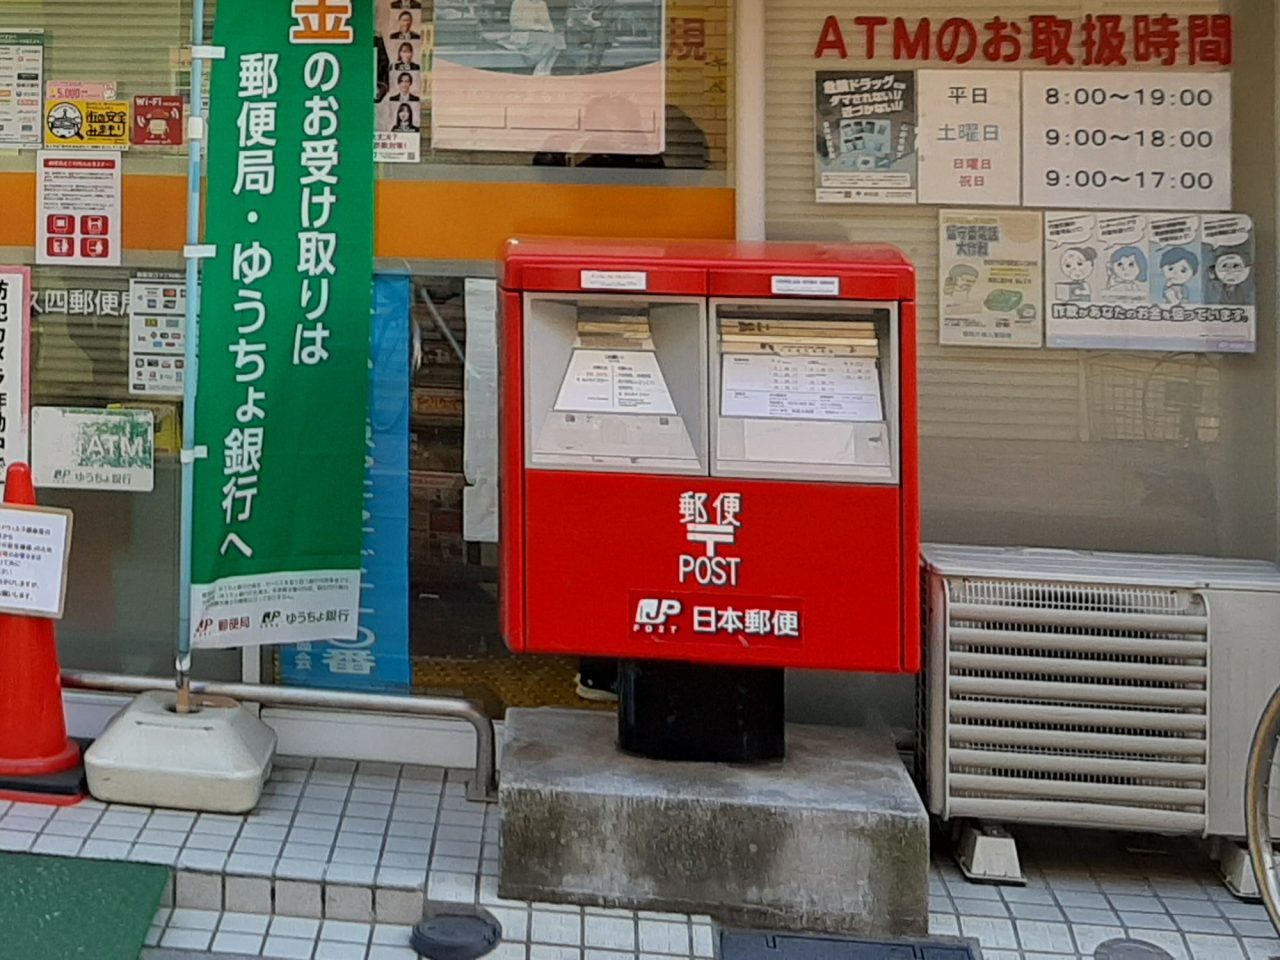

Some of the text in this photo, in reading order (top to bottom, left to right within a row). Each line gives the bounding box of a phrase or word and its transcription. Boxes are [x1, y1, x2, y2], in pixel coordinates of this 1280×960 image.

[815, 14, 1233, 66] ATMのお取扱時間
[948, 86, 988, 105] 平日
[1045, 87, 1214, 107] 8:00～19:00
[937, 124, 1000, 143] 土曜日
[1045, 128, 1214, 149] 9:00～18:00
[953, 158, 992, 172] 日曜日
[959, 175, 985, 188] 祝日
[1045, 169, 1214, 190] 9:00～17:00
[218, 52, 281, 559] 郵便局・ゆうちょ銀行へ
[85, 435, 146, 459] ATM
[678, 491, 741, 526] 郵便
[678, 554, 741, 586] POST
[218, 616, 250, 631] 郵便局
[285, 609, 350, 625] ゆうちょ銀行
[693, 606, 800, 636] 日本郵便
